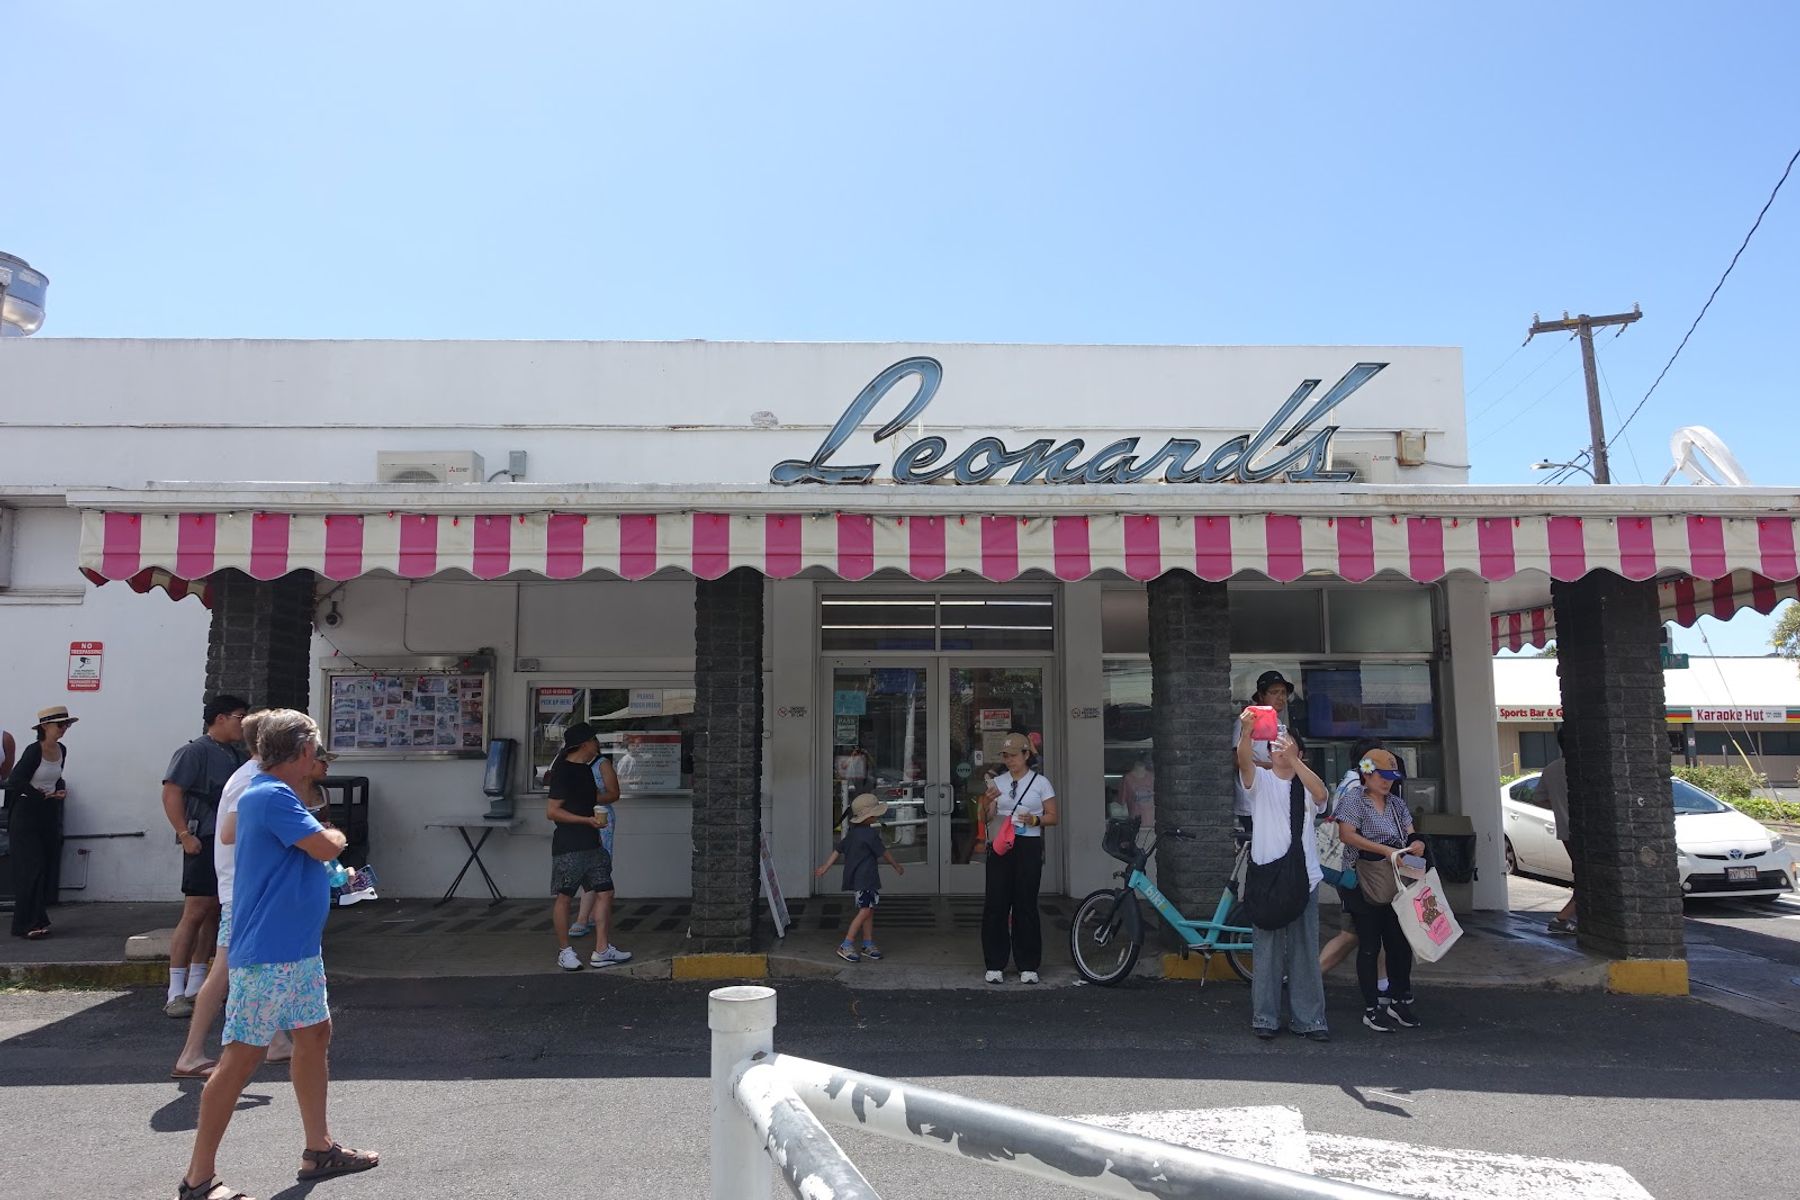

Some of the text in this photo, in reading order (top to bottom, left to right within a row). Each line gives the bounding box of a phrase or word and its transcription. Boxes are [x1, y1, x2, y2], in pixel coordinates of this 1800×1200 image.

[769, 355, 1391, 485] Leonard's
[1500, 709, 1527, 720] Sports
[1530, 708, 1545, 717] Bar
[1547, 708, 1554, 717] &
[1697, 709, 1742, 721] Karaoke
[1745, 709, 1764, 721] Hut
